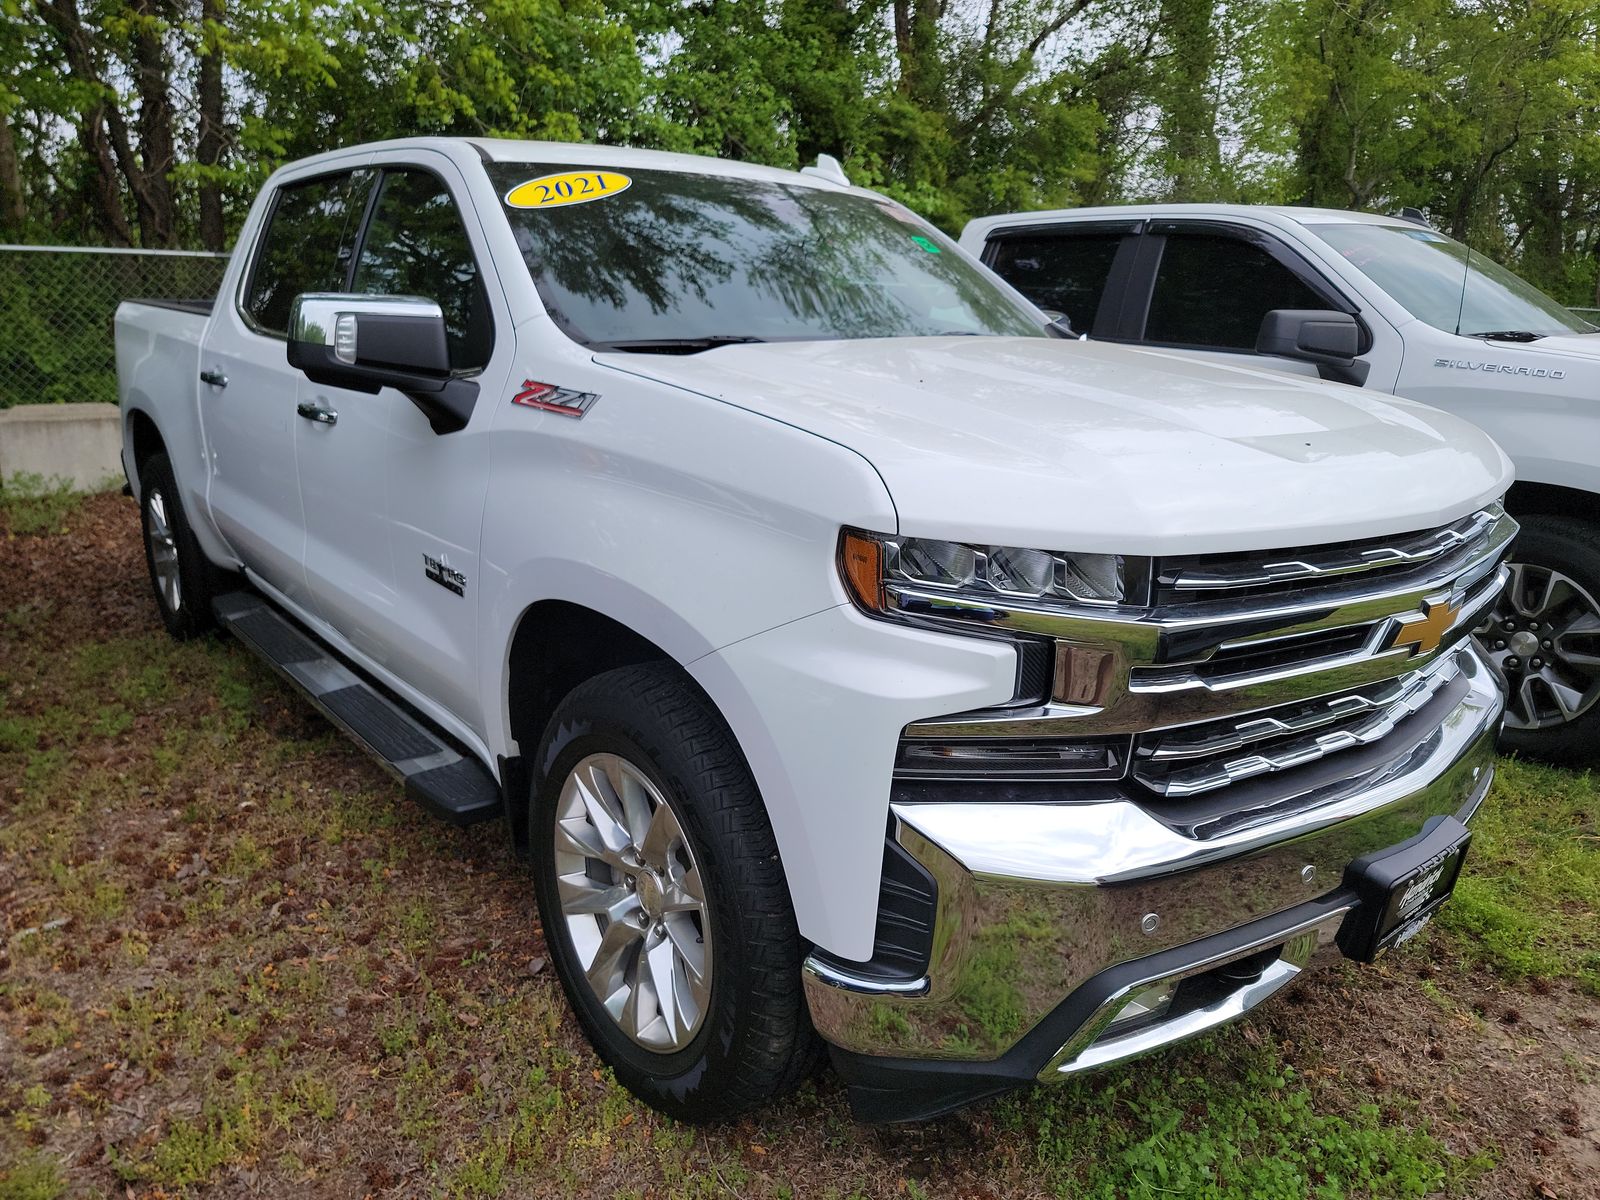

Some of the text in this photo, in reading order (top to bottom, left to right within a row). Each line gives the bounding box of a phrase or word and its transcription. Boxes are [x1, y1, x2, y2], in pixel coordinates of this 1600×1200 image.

[534, 174, 608, 204] 2021
[1434, 358, 1567, 380] SILVERADO
[511, 379, 600, 419] Z71
